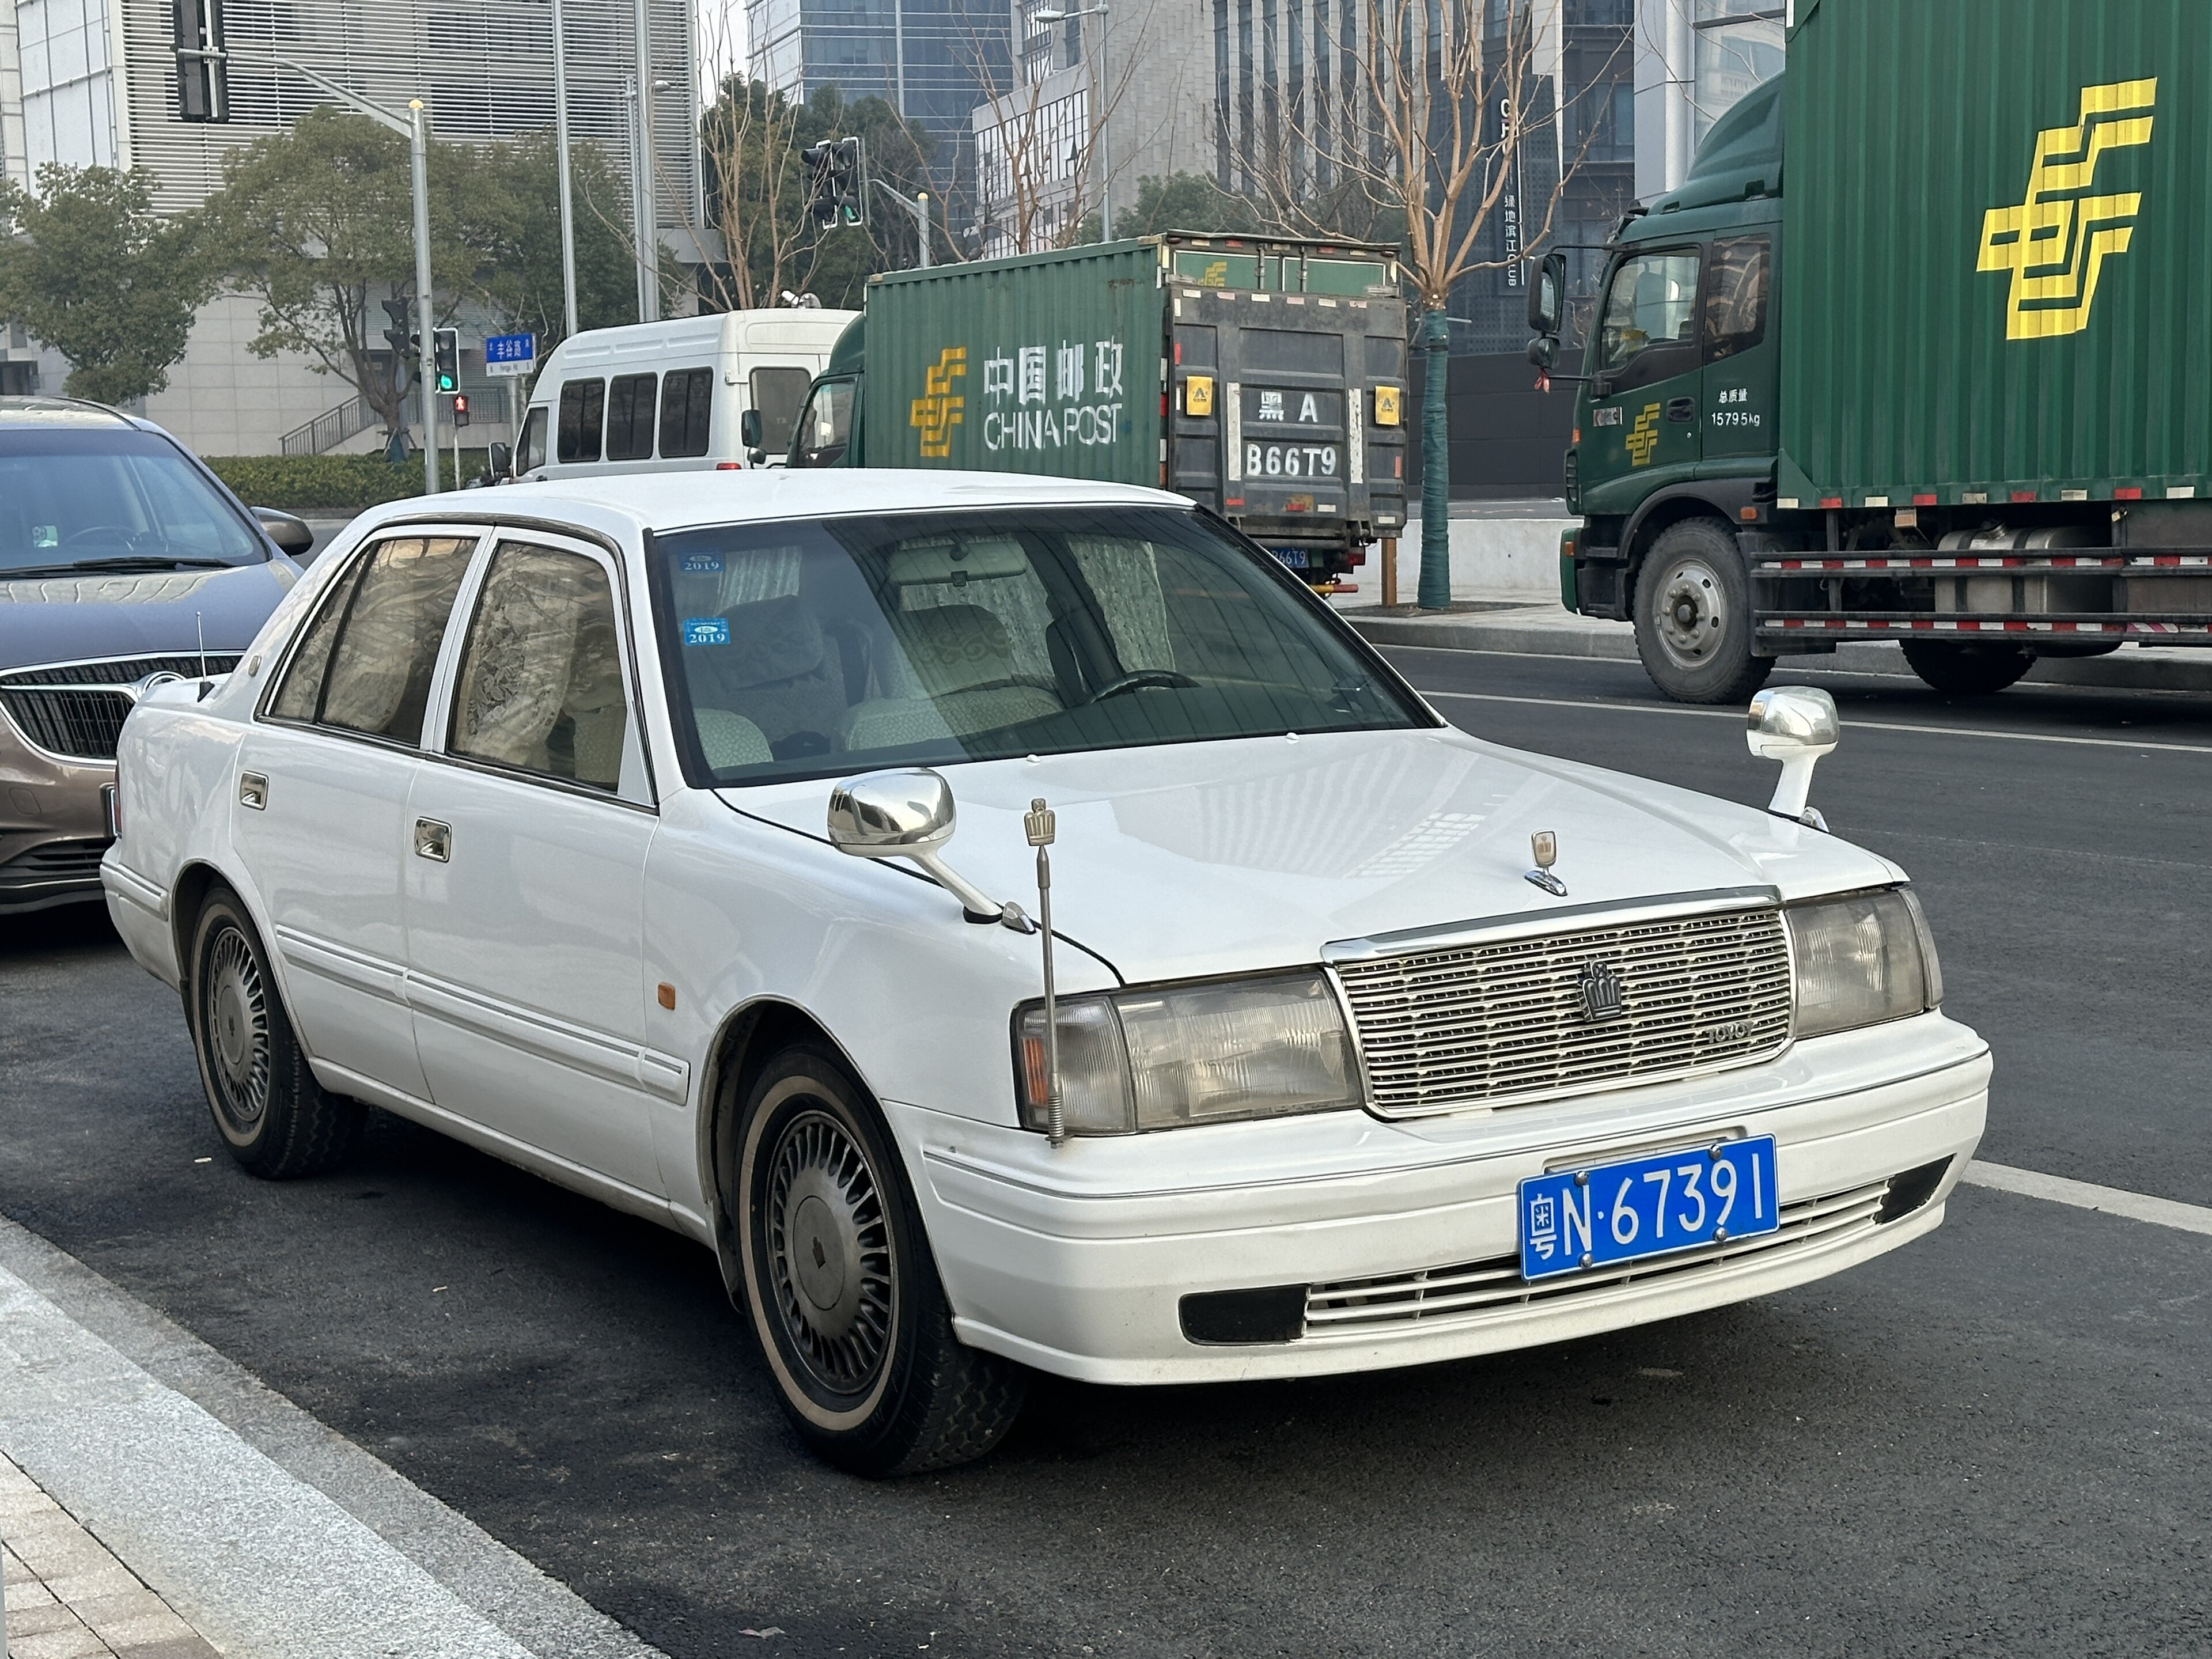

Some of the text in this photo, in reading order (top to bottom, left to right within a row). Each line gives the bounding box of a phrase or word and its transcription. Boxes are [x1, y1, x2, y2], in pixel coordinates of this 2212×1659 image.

[984, 335, 1123, 407] 中国邮政
[1259, 391, 1318, 422] 黑 A
[1719, 388, 1748, 403] 总质量
[984, 403, 1122, 450] CHINA POST
[1711, 412, 1760, 427] 15795kg
[1247, 444, 1336, 476] B66T9
[684, 562, 719, 571] 2019
[689, 633, 725, 643] 2019
